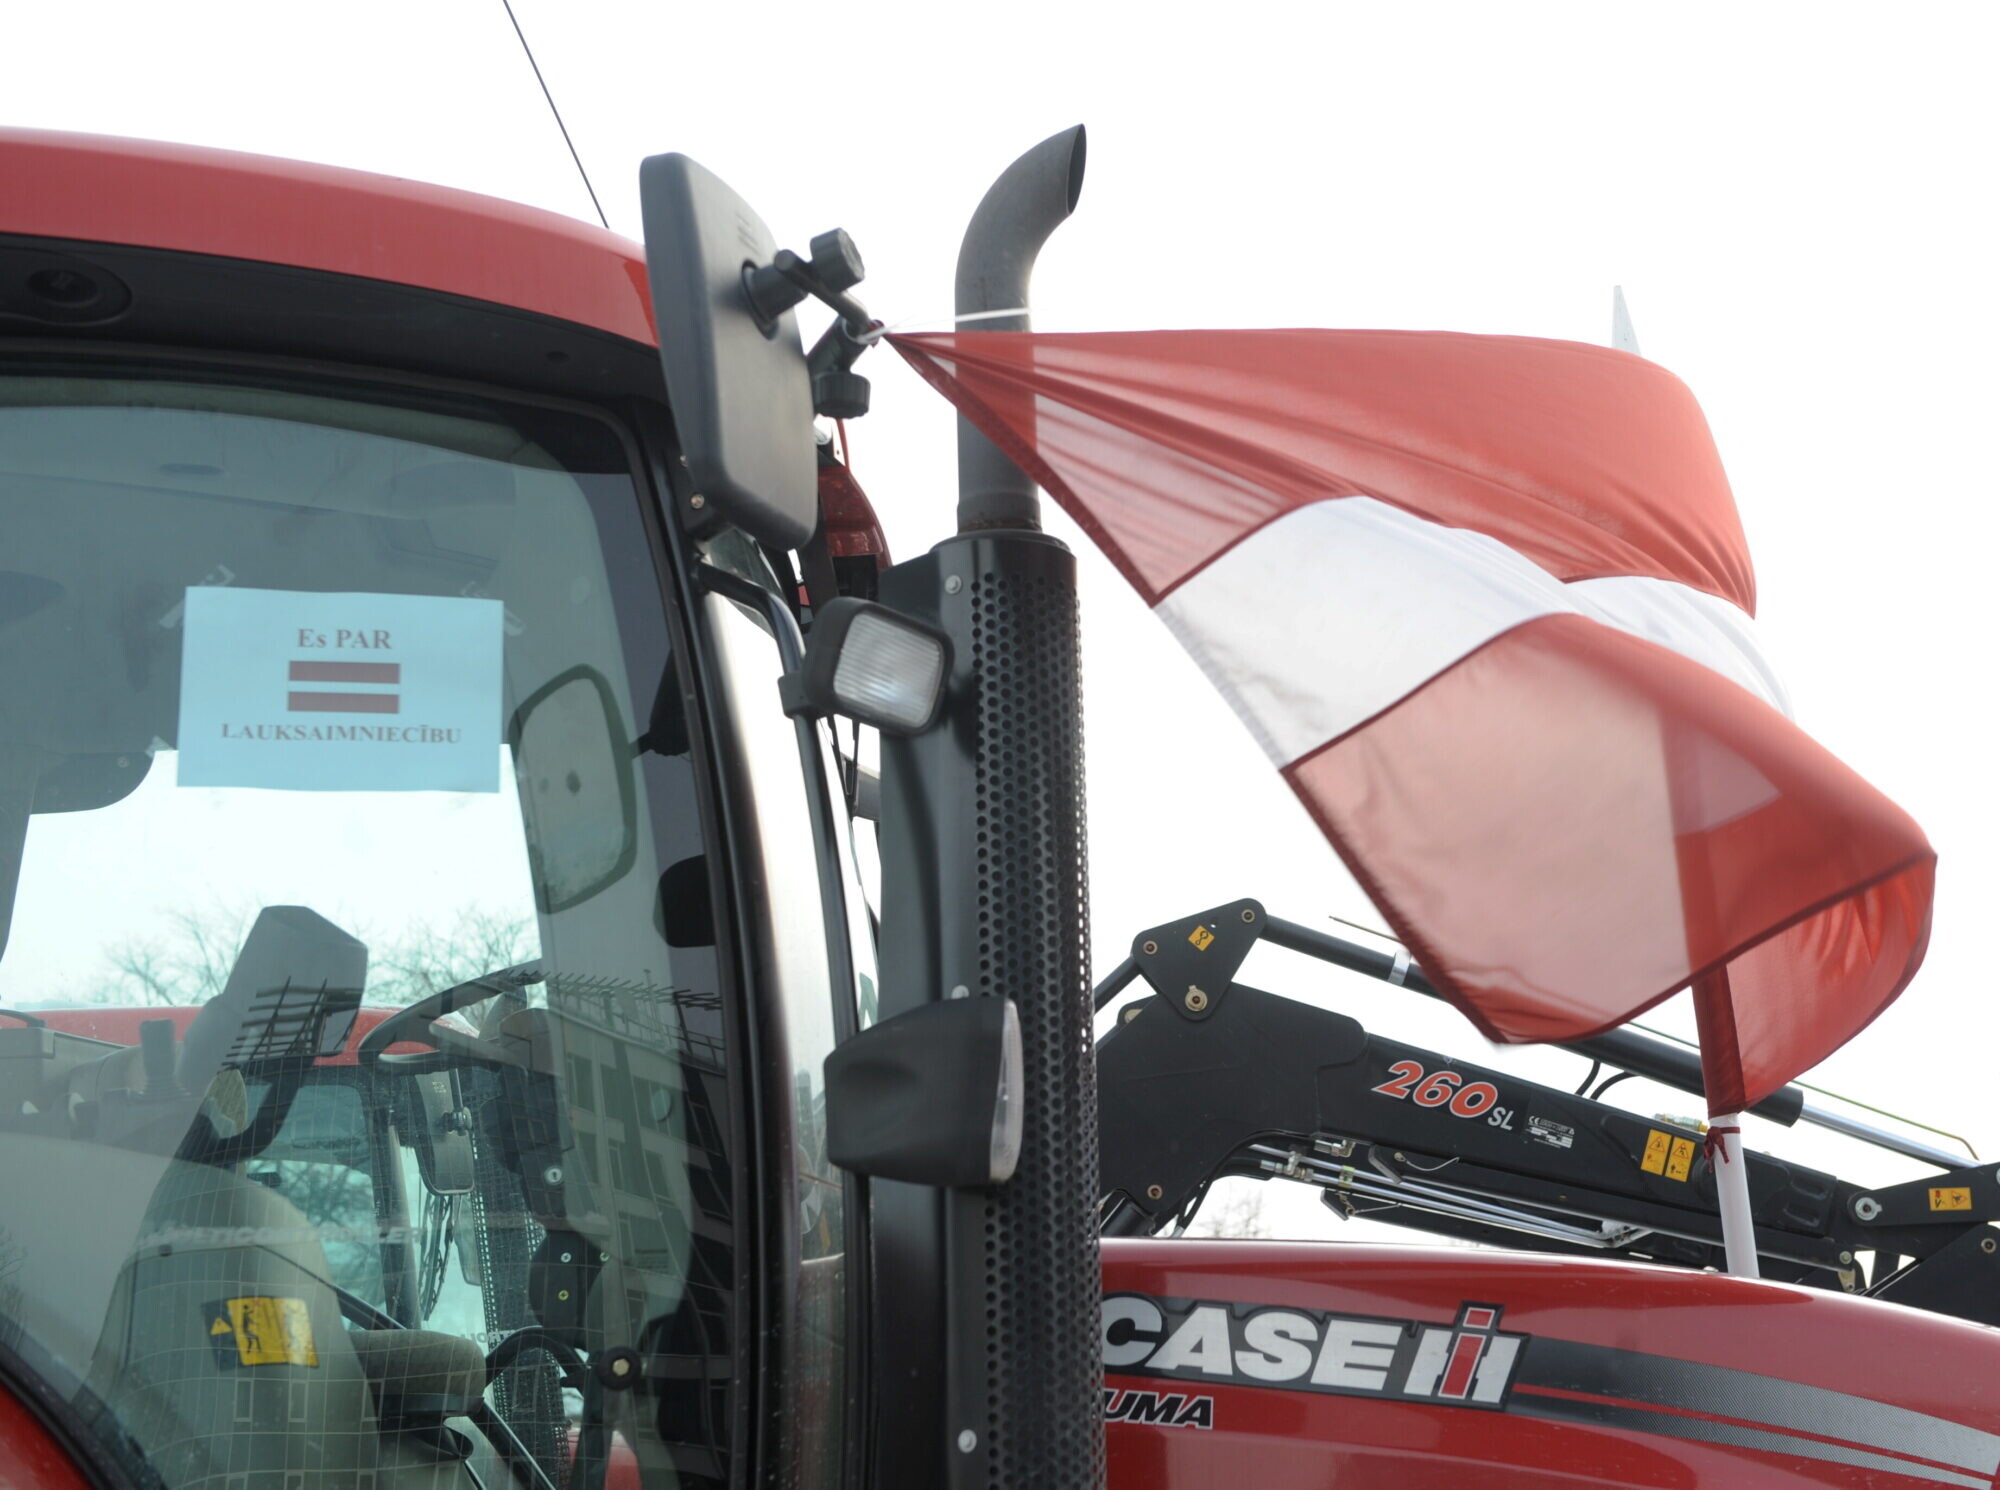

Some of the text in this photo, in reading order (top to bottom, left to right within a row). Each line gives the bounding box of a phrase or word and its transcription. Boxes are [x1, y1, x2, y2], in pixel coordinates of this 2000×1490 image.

[297, 628, 392, 650] Es PAR
[221, 723, 462, 745] LAUKSAIMNIECĪBU
[1371, 1060, 1513, 1131] 260 SL
[1101, 1296, 1403, 1391] CASE
[1103, 1388, 1214, 1430] UMA
